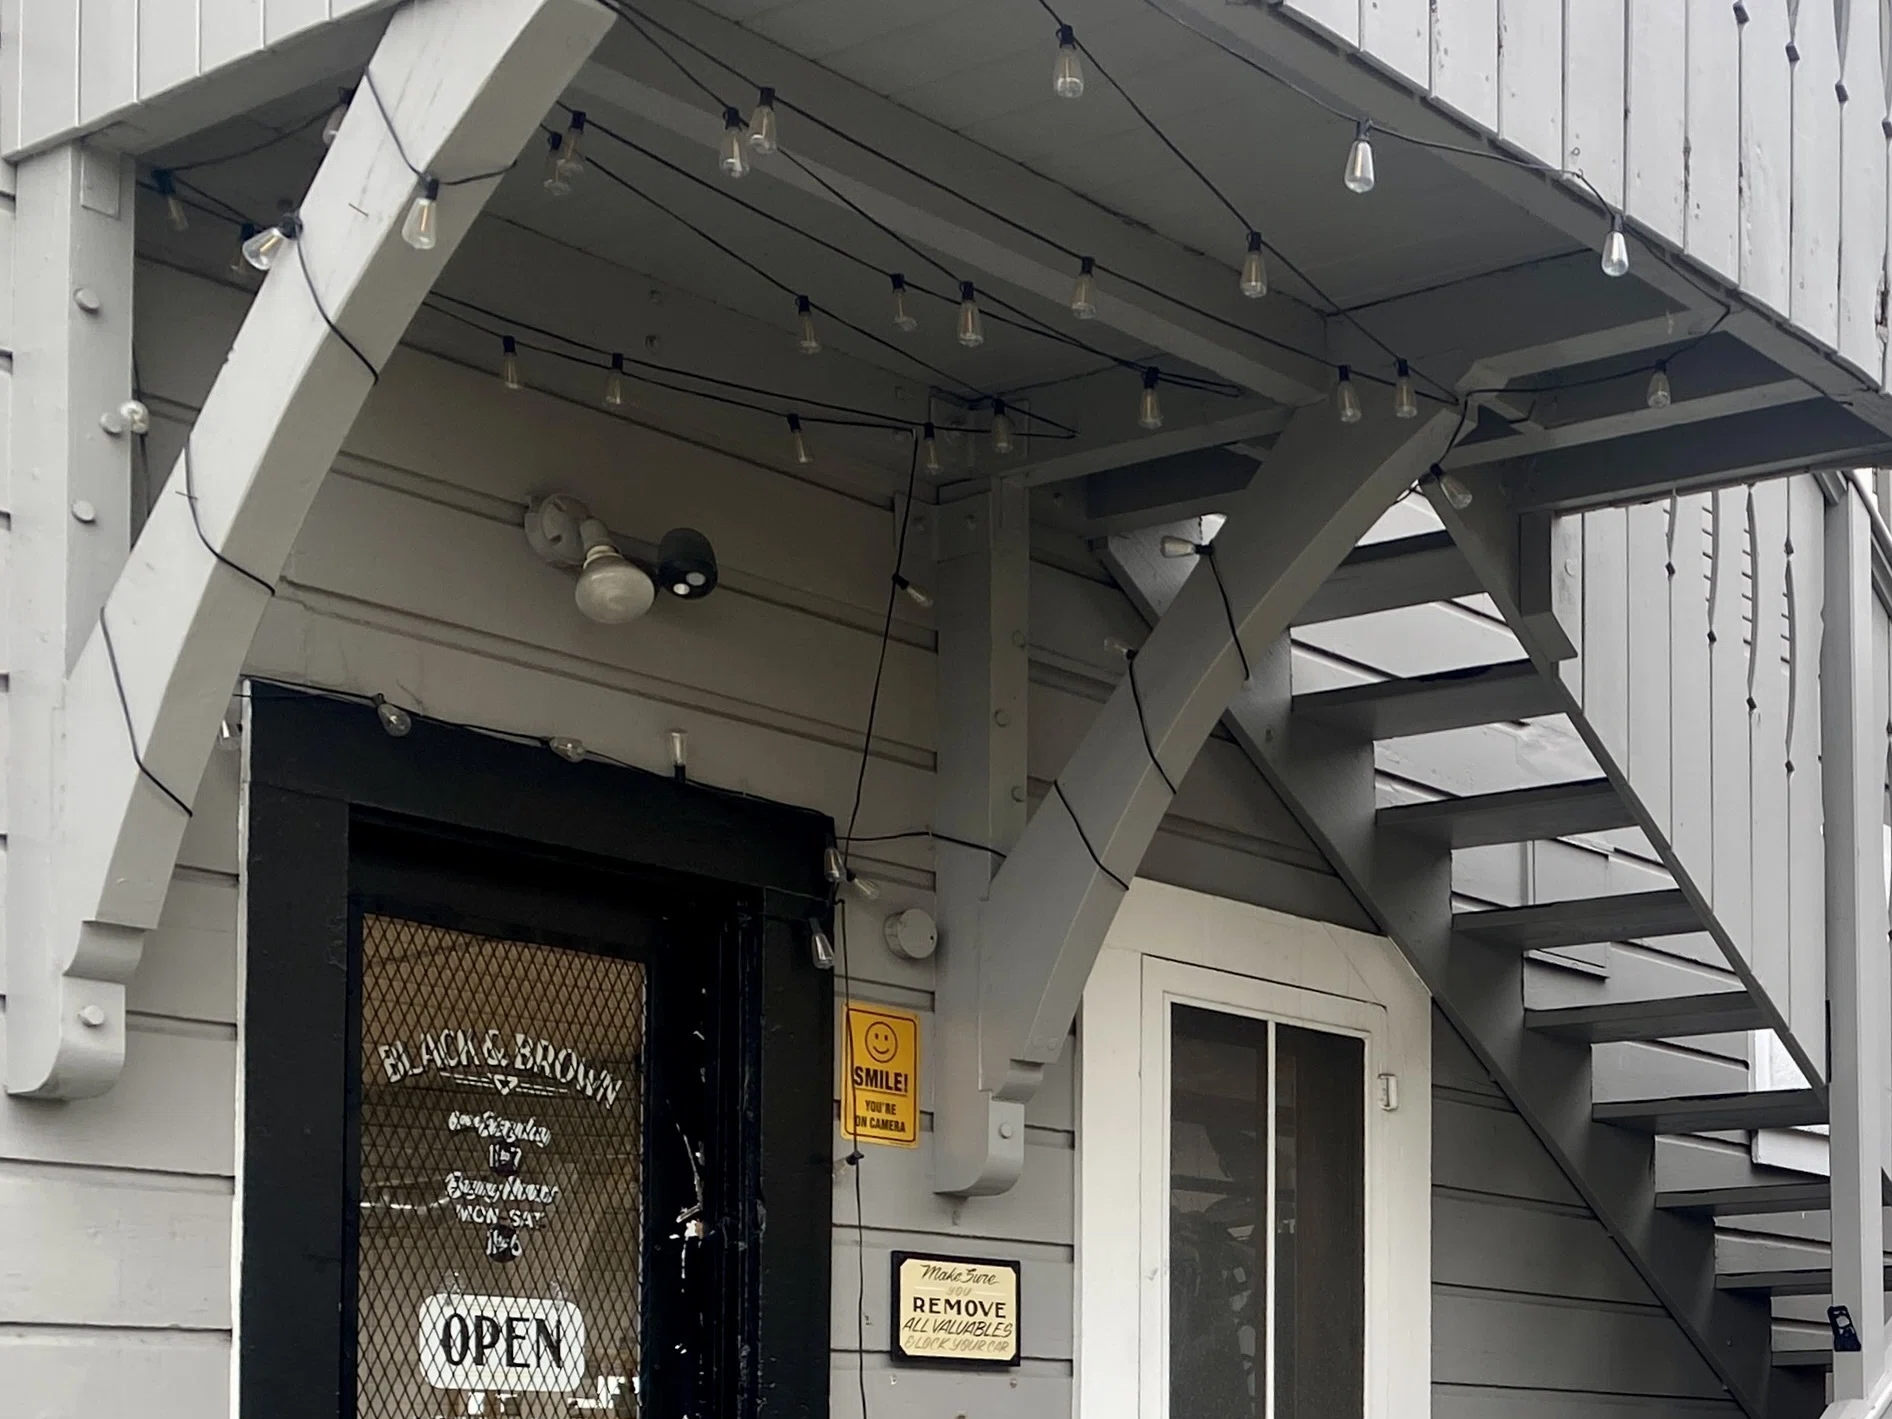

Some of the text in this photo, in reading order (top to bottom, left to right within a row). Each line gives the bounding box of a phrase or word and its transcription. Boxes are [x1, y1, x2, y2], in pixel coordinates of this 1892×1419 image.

[378, 1028, 623, 1110] BLACK & BROWN
[854, 1066, 908, 1093] SMILE!
[865, 1100, 897, 1116] YOU'RE
[855, 1114, 906, 1133] ON CAMERA
[920, 1264, 1000, 1285] Make Sure
[945, 1286, 972, 1296] YOU
[913, 1296, 1006, 1319] REMOVE
[902, 1317, 1013, 1338] ALL VALUABLES
[440, 1312, 564, 1369] OPEN
[914, 1336, 951, 1350] LOCK
[952, 1338, 985, 1352] YOUR
[986, 1340, 1010, 1353] CAR
